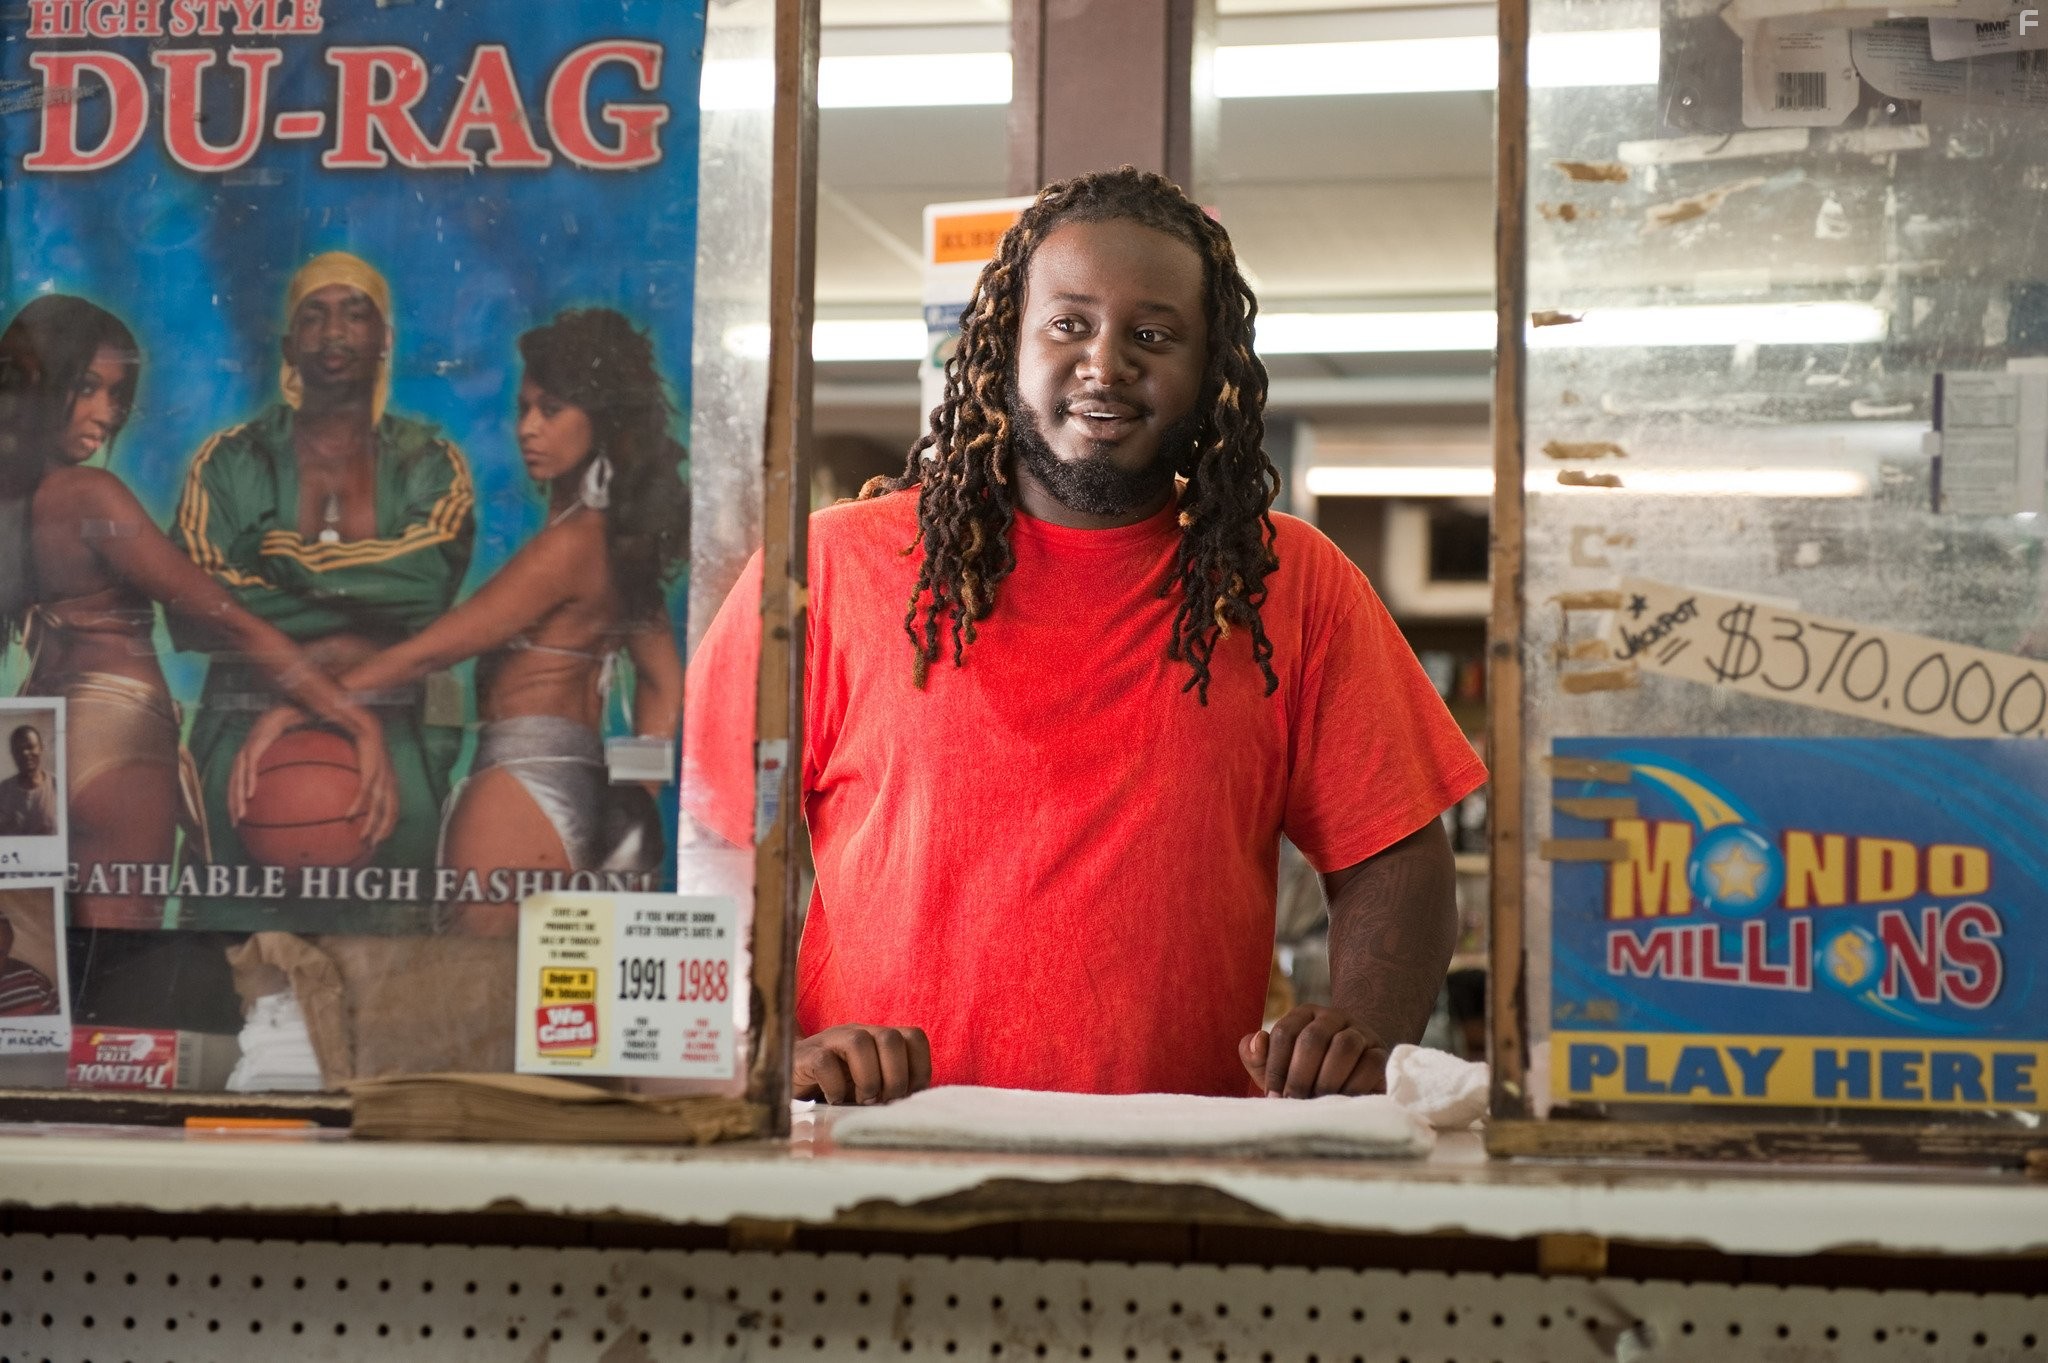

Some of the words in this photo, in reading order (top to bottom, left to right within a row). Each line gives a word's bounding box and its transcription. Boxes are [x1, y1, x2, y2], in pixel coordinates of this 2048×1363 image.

[26, 0, 163, 38] HIGH
[168, 0, 323, 37] STYLE
[1976, 20, 2010, 34] MMF
[23, 40, 669, 172] DU-RAG
[299, 867, 418, 900] HIGH
[1607, 817, 1992, 920] MONDO
[1606, 901, 2003, 1010] MILLIONS
[618, 958, 667, 1000] 1991
[677, 959, 729, 1003] 1988
[540, 1021, 594, 1044] Card
[547, 1006, 586, 1026] We
[76, 1064, 167, 1089] TYLENOL
[1568, 1043, 1784, 1098] PLAY
[1813, 1047, 2038, 1105] HERE
